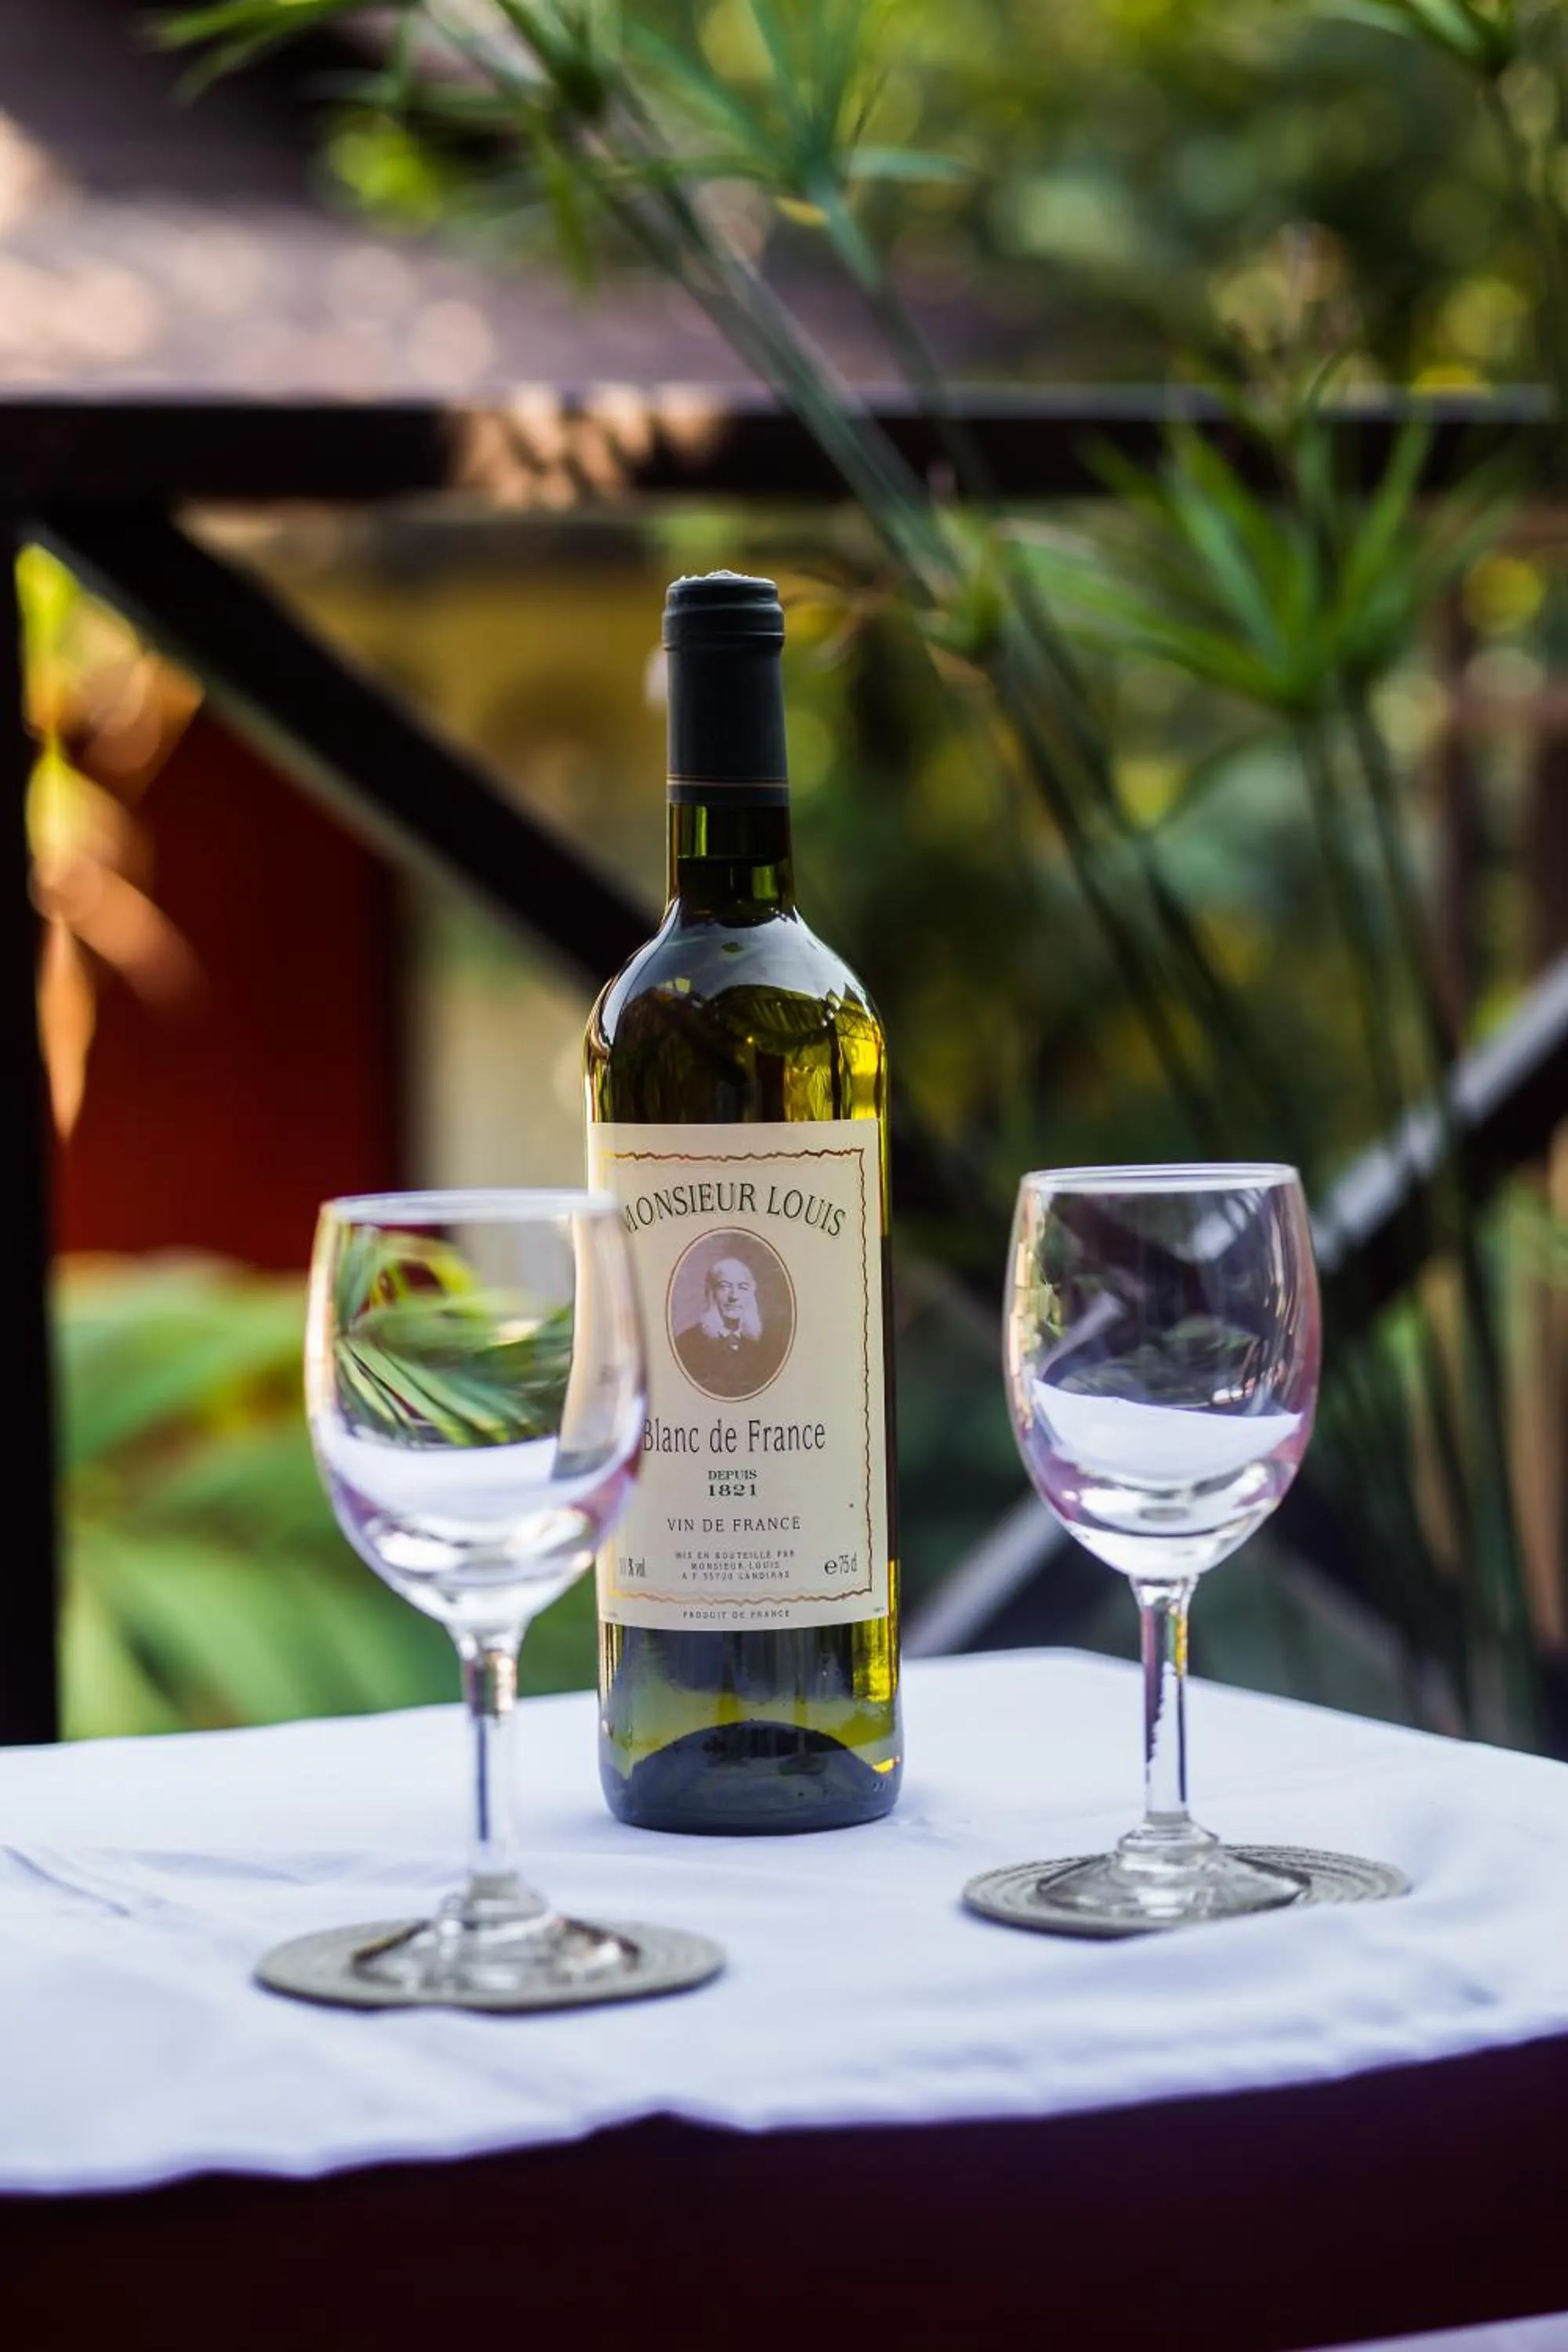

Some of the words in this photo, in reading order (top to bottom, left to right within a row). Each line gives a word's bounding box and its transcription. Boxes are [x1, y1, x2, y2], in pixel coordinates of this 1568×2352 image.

[766, 1186, 846, 1236] LOUIS
[643, 1417, 700, 1453] Blanc
[709, 1417, 737, 1453] de
[748, 1419, 826, 1452] France
[707, 1468, 758, 1481] DEPUIS
[707, 1483, 757, 1497] 1821
[666, 1518, 695, 1532] VIN
[702, 1519, 724, 1533] DE
[732, 1516, 801, 1532] FRANCE
[691, 1561, 744, 1571] MONSIEUR
[749, 1560, 780, 1570] LOUIS
[750, 1609, 790, 1619] FRANCE
